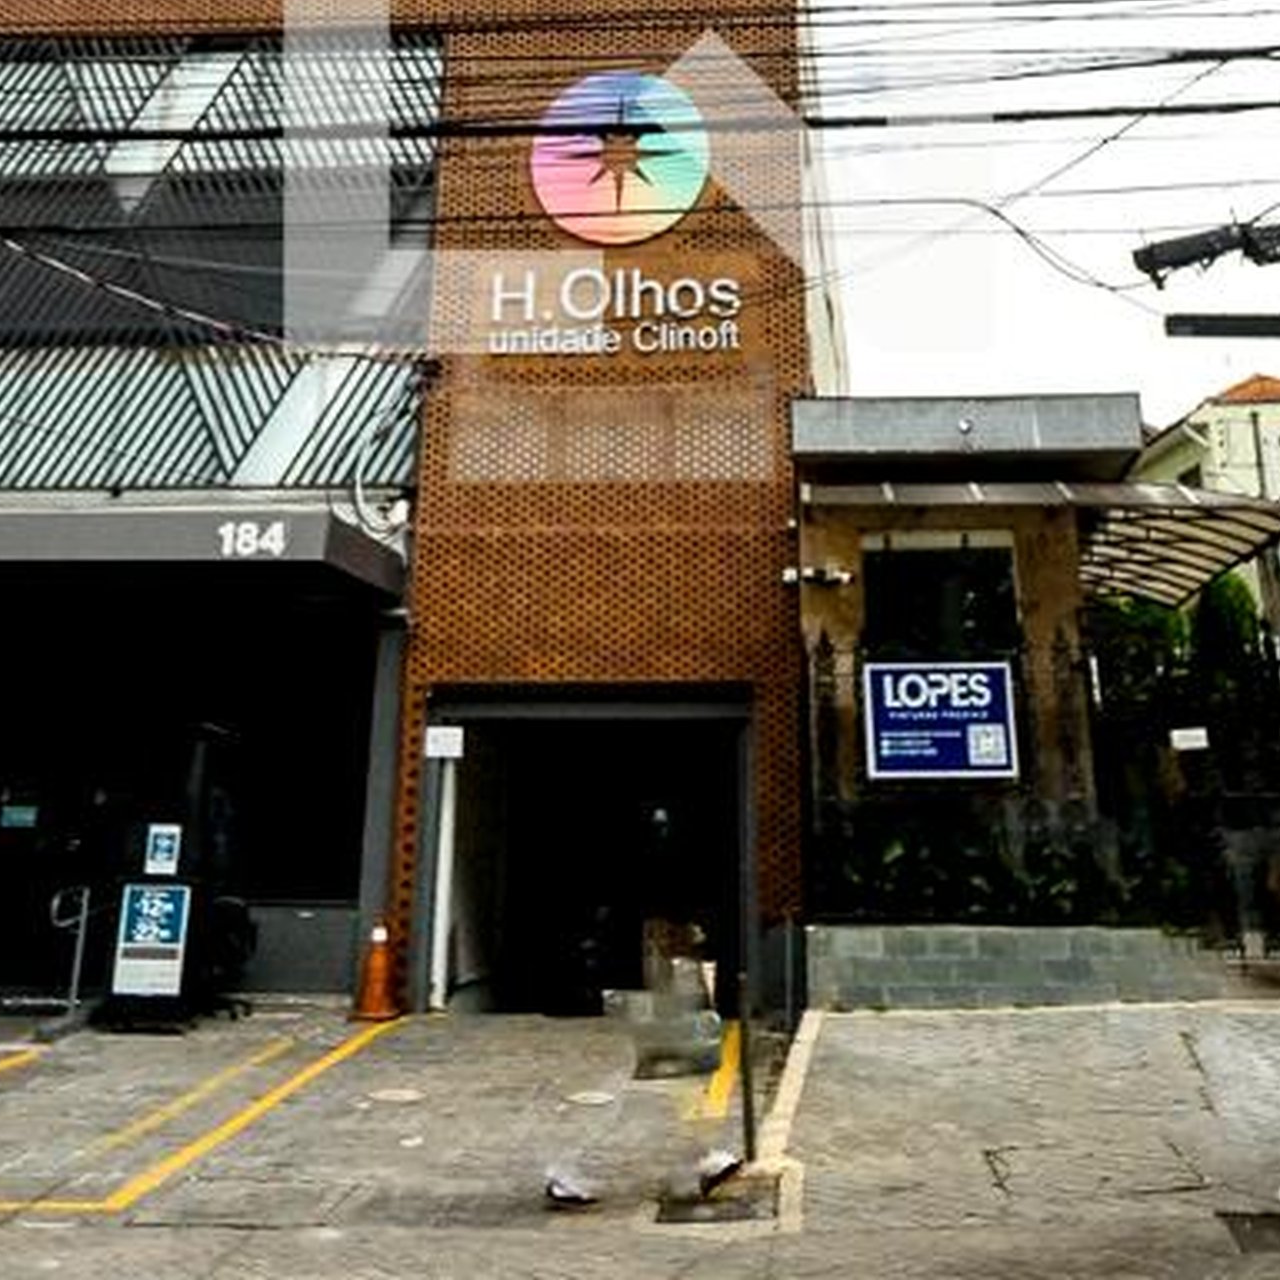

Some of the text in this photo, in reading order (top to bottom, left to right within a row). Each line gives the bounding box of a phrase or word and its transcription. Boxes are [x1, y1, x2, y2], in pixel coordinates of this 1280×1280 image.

[491, 267, 741, 321] H.Olhos
[487, 324, 620, 354] unidade
[218, 521, 285, 556] 184
[883, 673, 991, 707] LOPES
